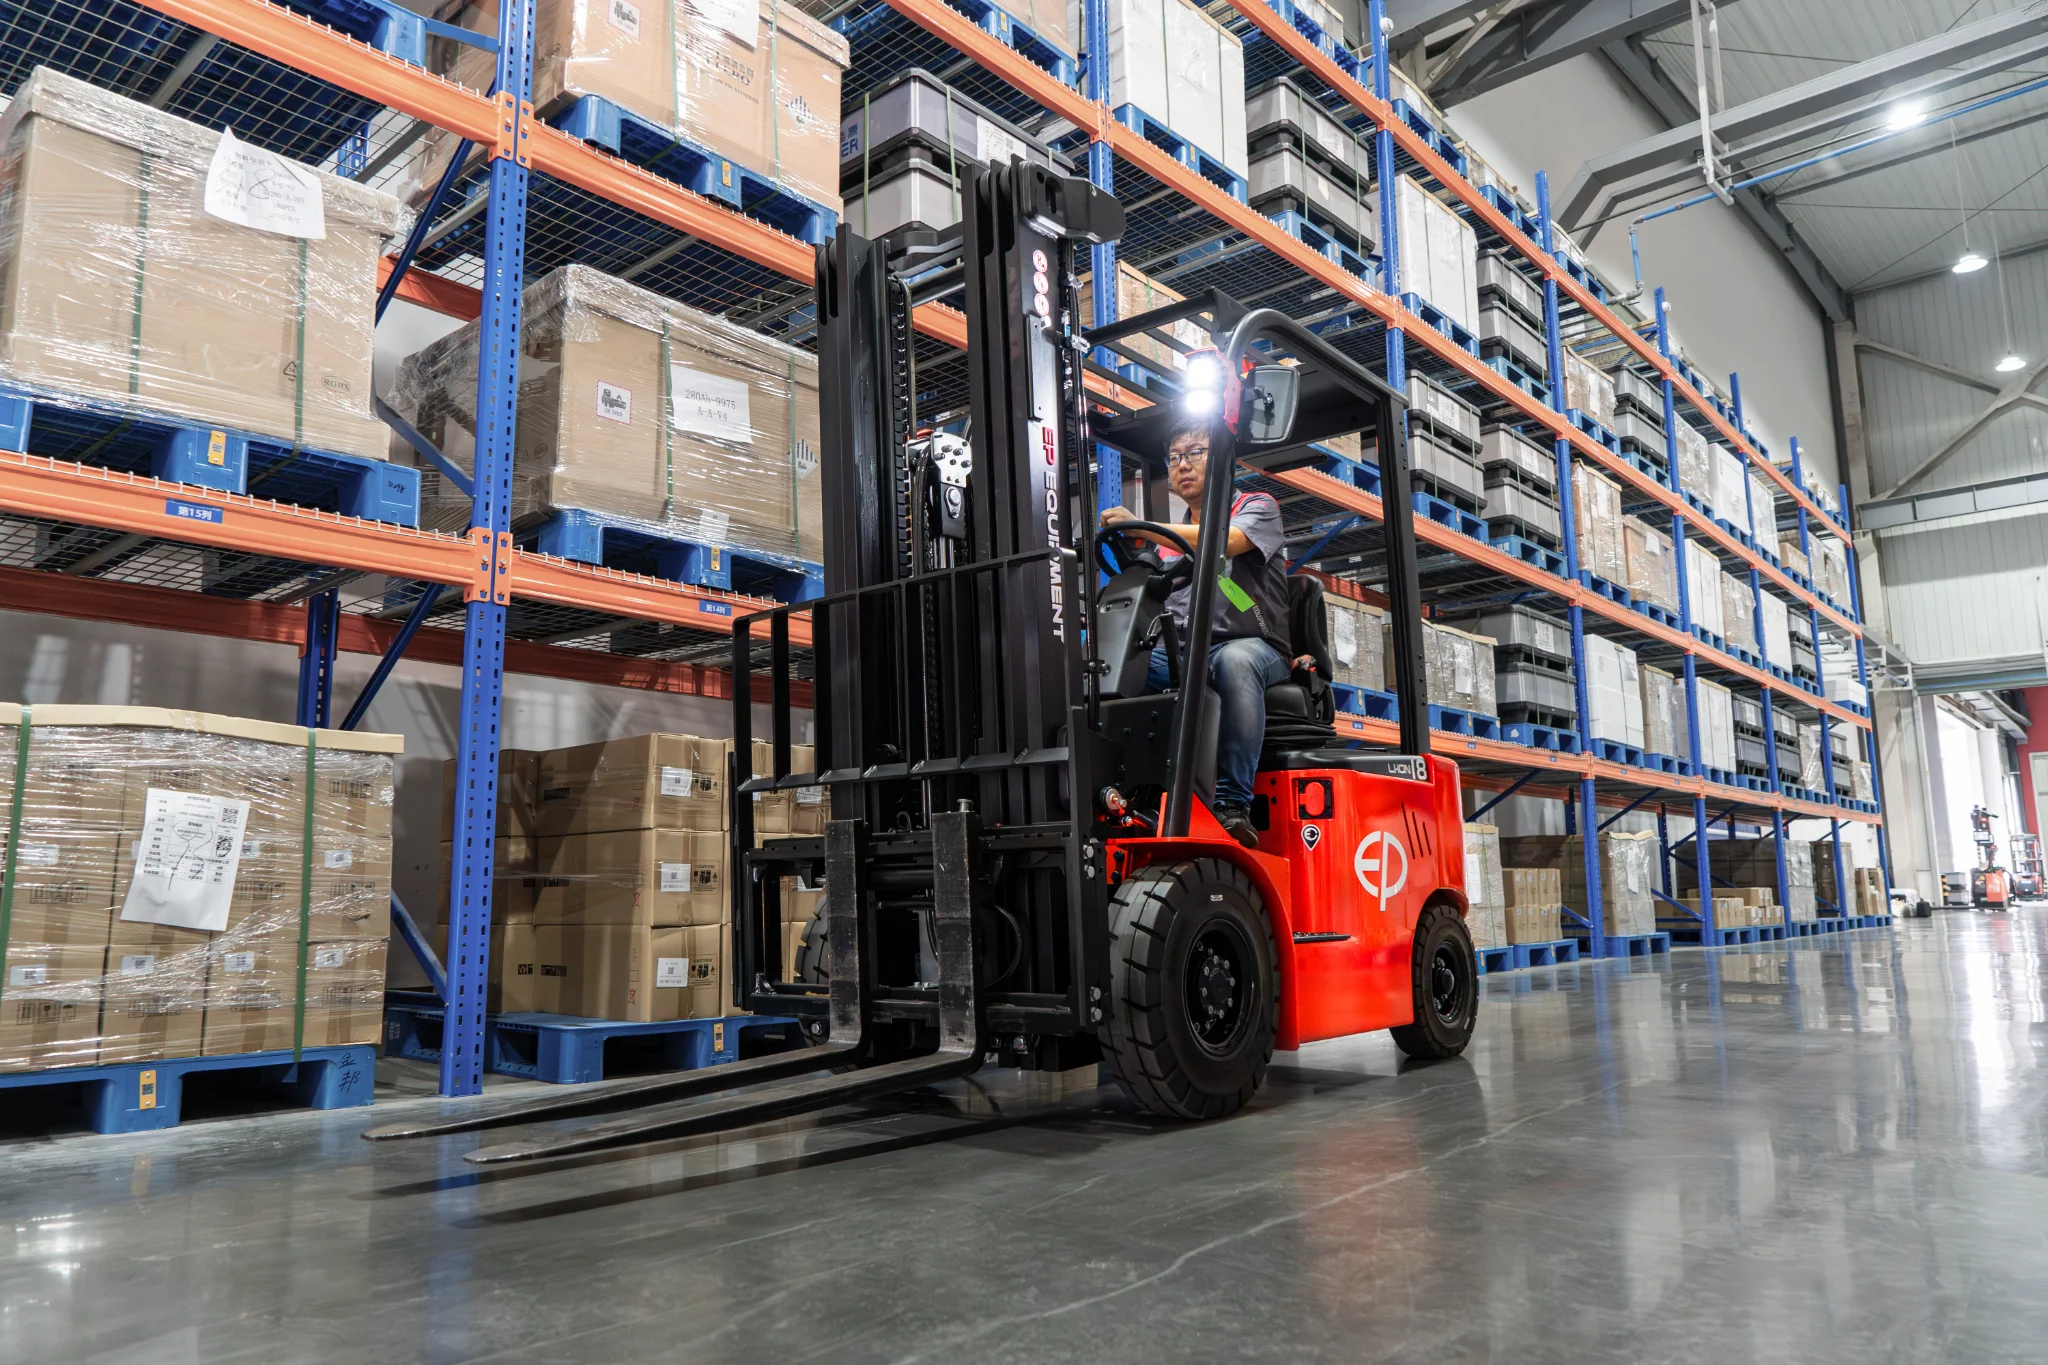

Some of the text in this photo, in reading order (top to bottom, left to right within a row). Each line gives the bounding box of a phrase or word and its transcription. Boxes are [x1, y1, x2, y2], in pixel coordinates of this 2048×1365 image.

[685, 389, 736, 410] 280Ah-9975
[697, 406, 728, 422] A-A-V4
[1042, 426, 1056, 466] EP
[178, 505, 213, 521] 第15列
[1410, 758, 1428, 780] 18
[1354, 830, 1408, 912] EP
